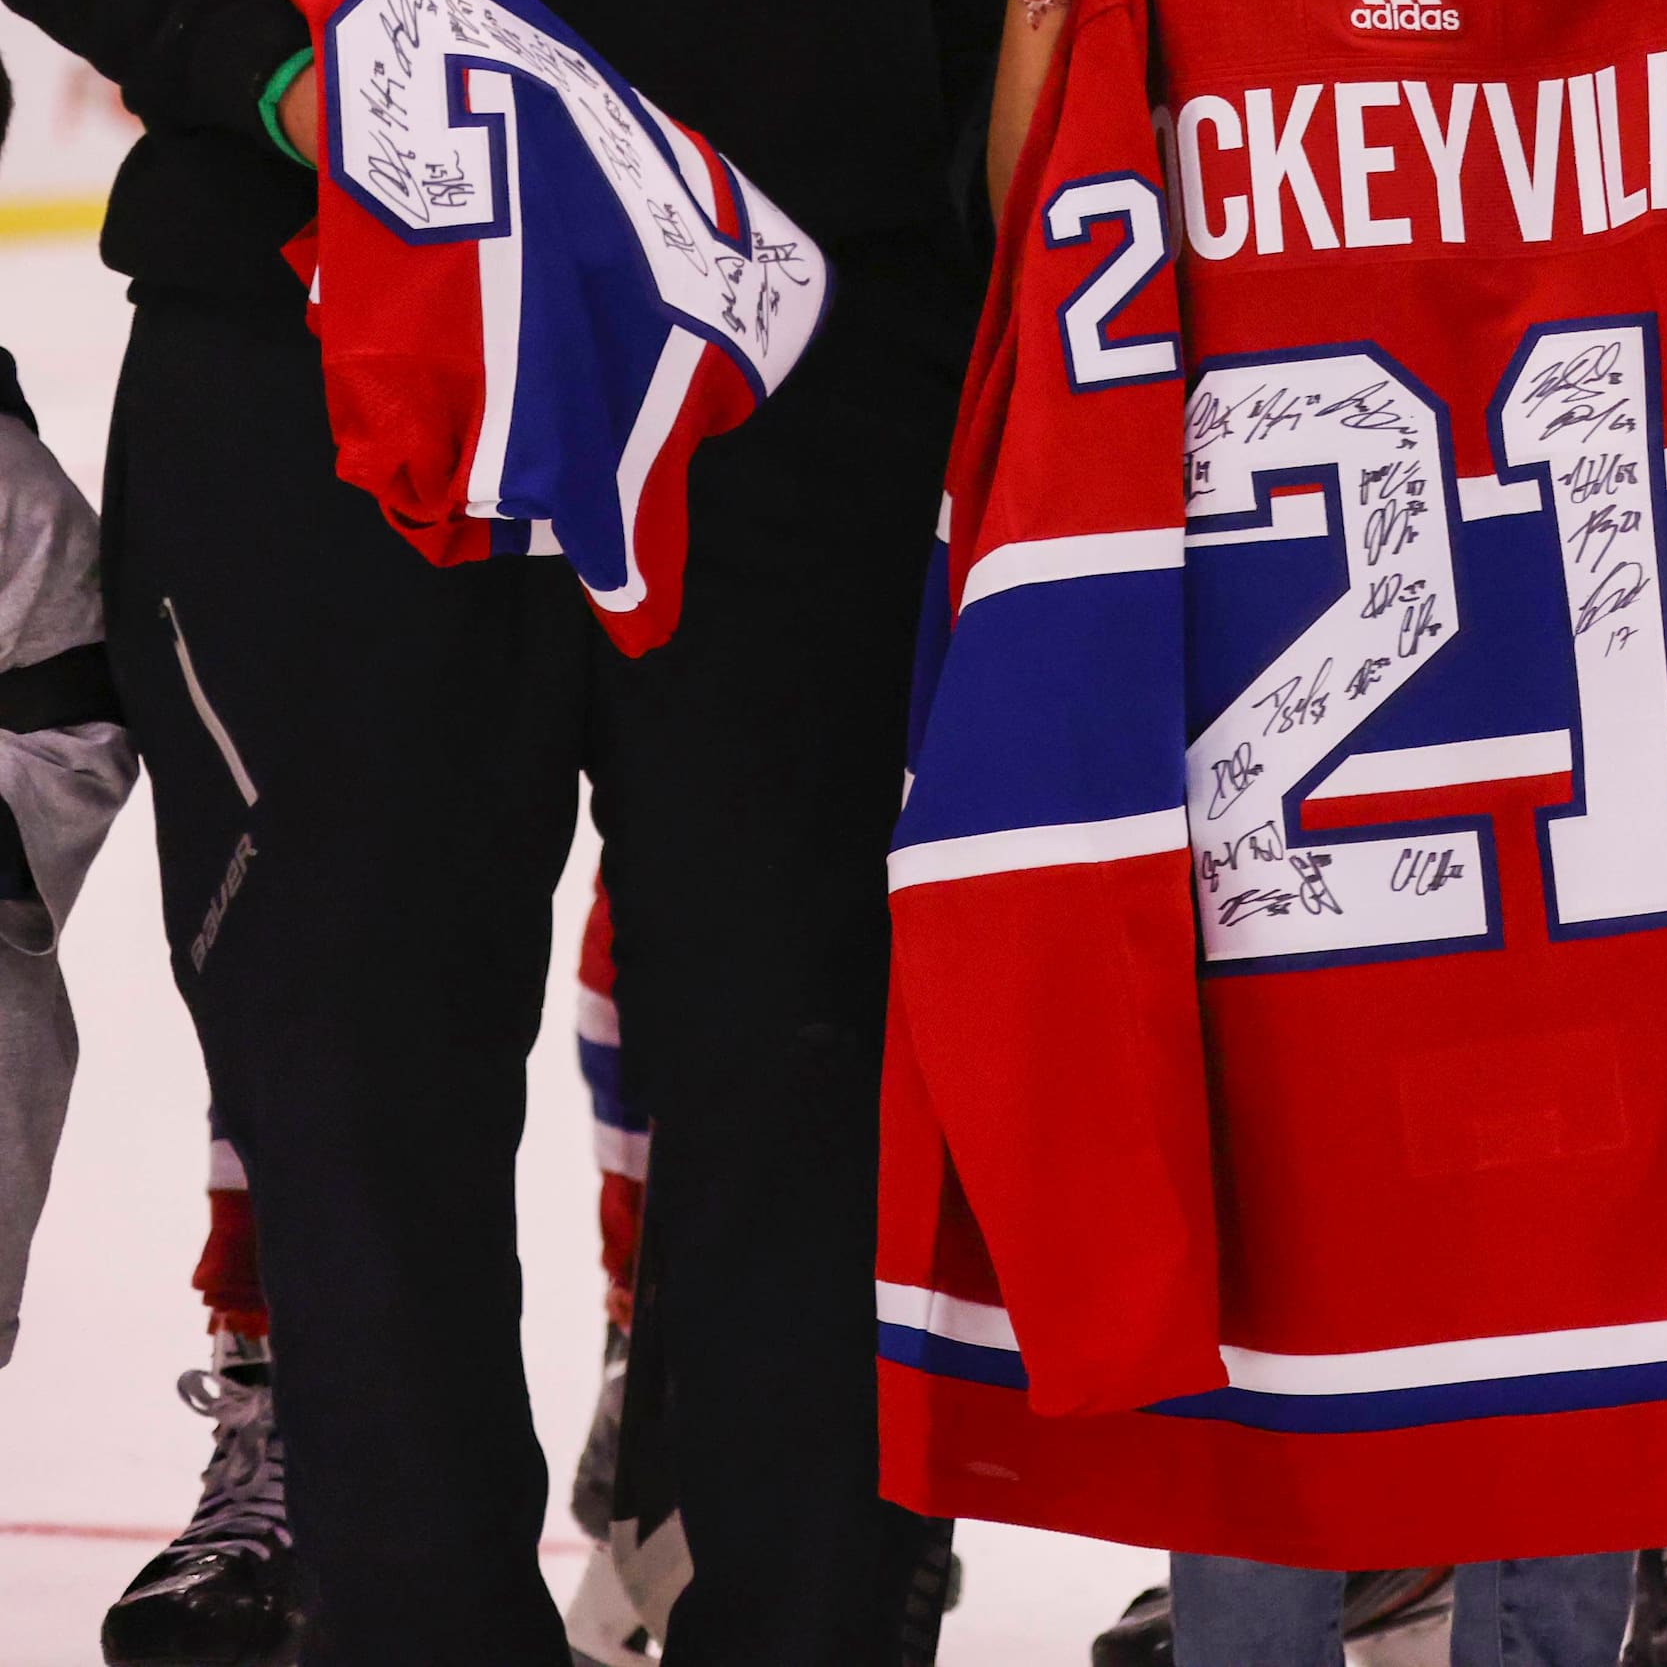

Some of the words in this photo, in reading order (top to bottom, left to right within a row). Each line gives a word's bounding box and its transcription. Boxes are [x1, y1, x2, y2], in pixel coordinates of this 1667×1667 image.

[1350, 3, 1461, 31] adidas
[1042, 169, 1181, 393] 2
[1604, 625, 1639, 658] 17
